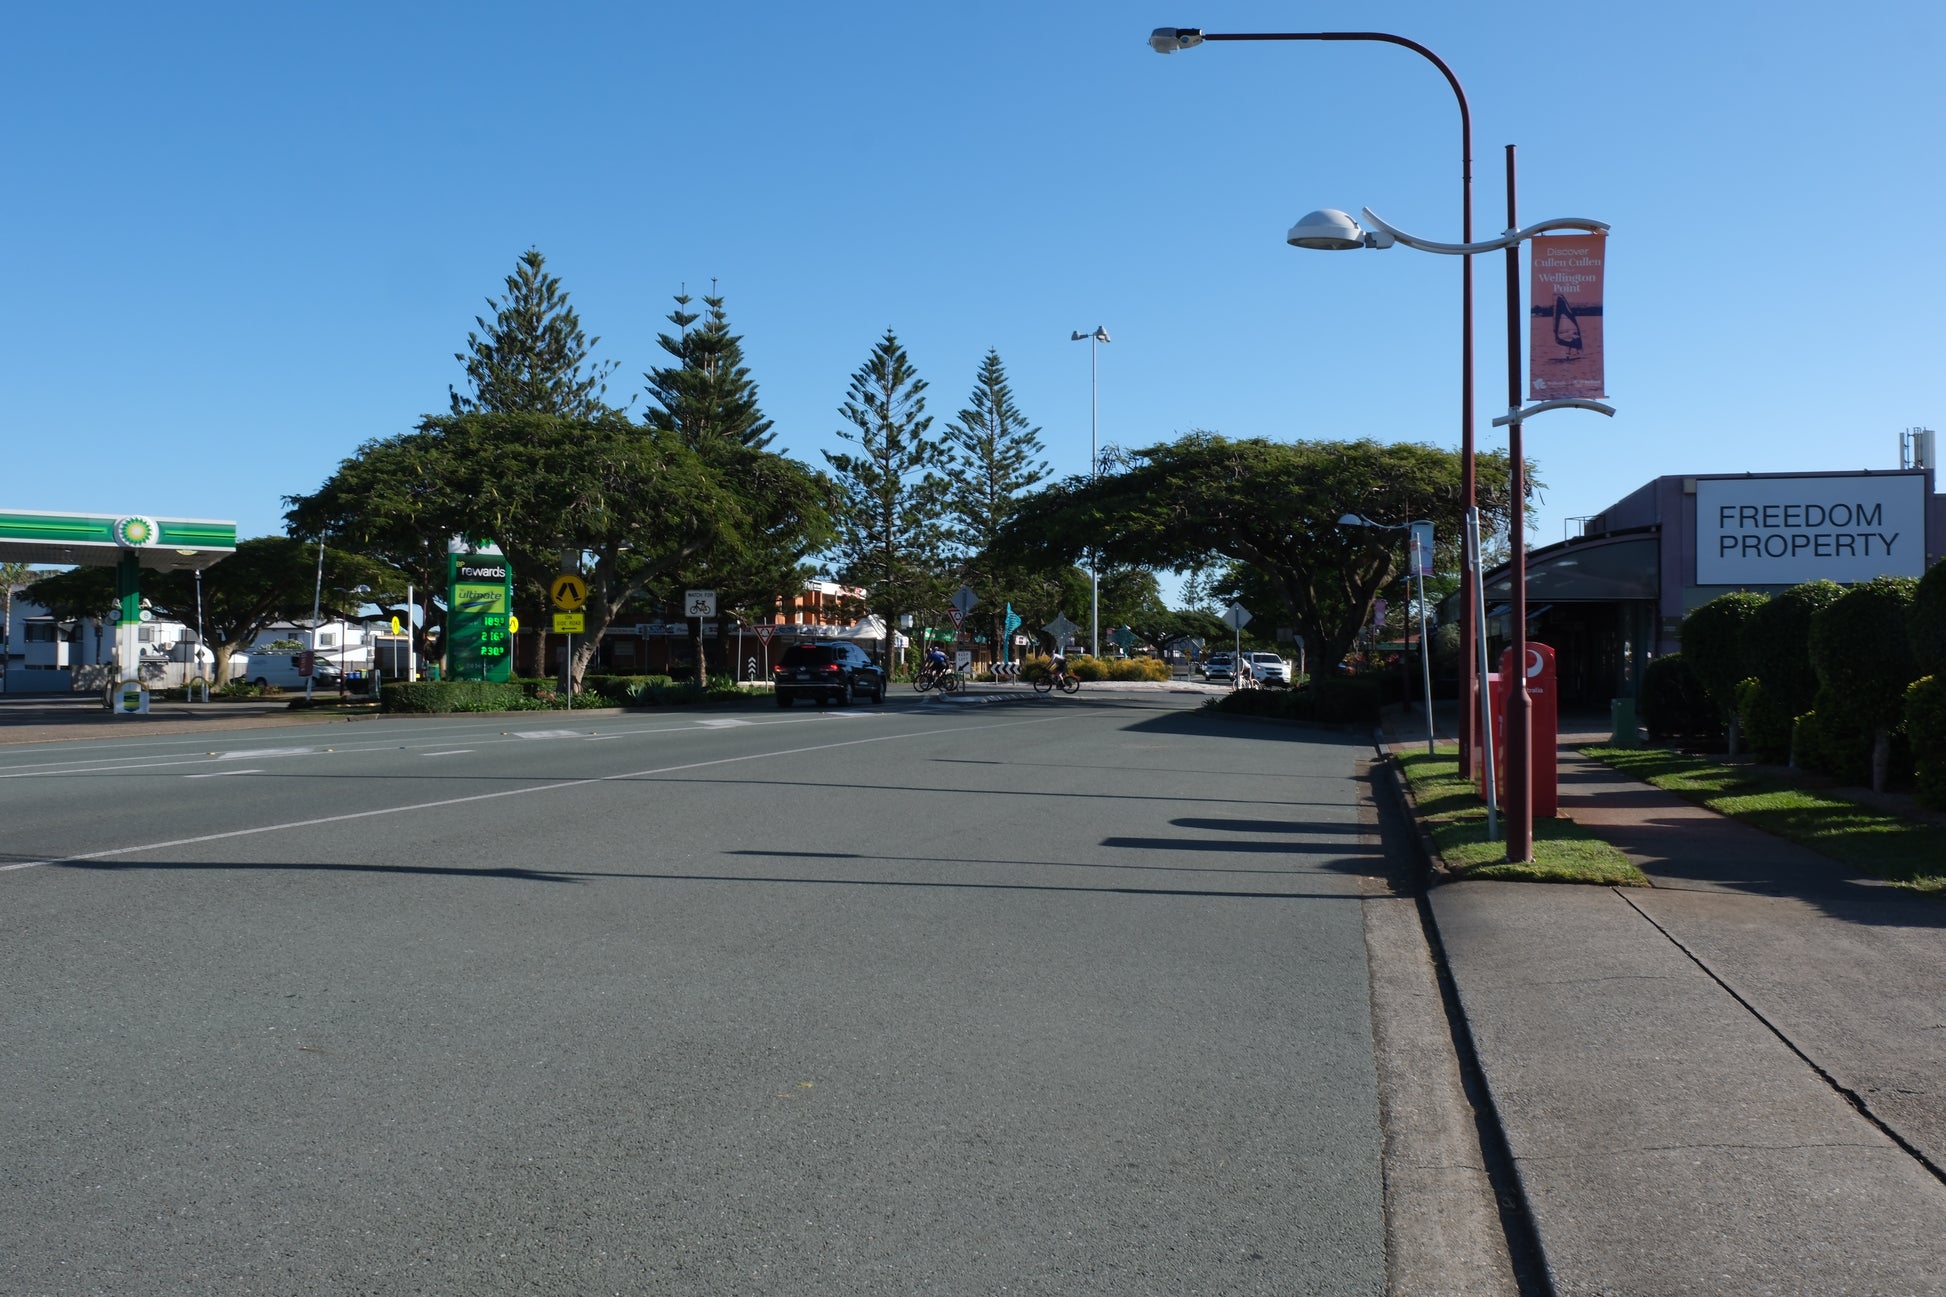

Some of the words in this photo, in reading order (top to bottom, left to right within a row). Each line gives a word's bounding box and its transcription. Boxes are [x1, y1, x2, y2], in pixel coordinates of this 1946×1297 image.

[1547, 247, 1590, 256] Discover
[1535, 258, 1566, 267] Cullen
[1568, 257, 1601, 266] Cullen
[1539, 272, 1596, 283] Wellington
[1553, 283, 1580, 293] Point
[1720, 503, 1882, 529] FREEDOM
[1720, 533, 1899, 558] PROPERTY
[461, 566, 506, 578] rewards
[459, 589, 502, 600] ultimate
